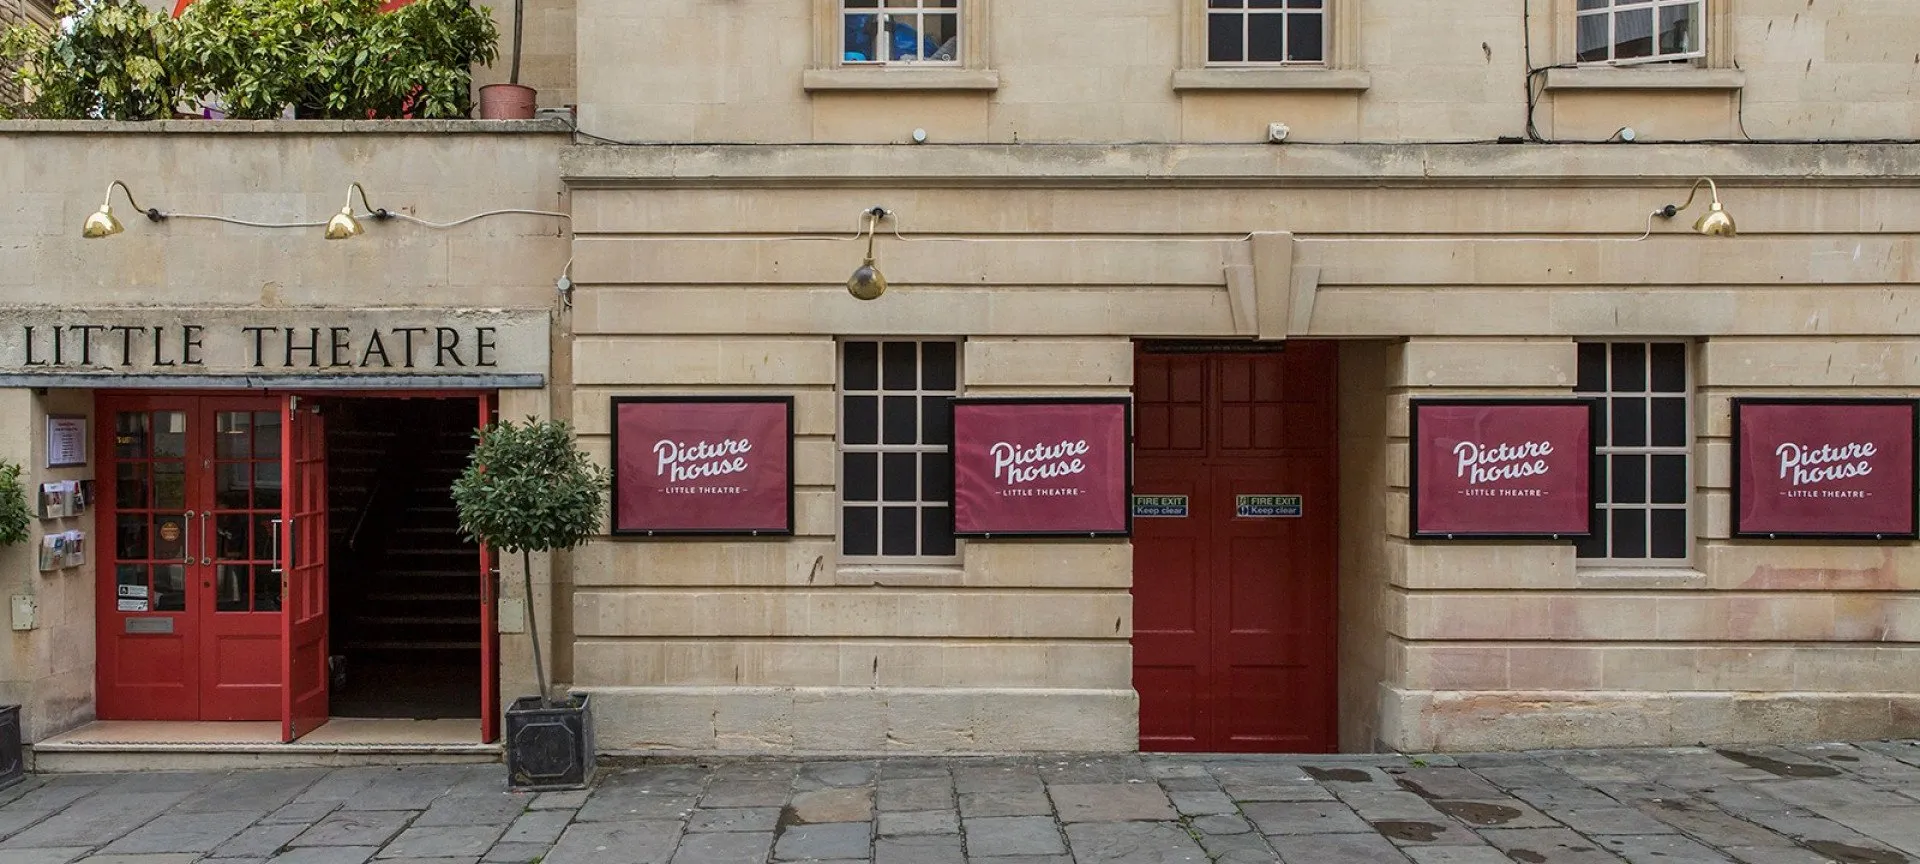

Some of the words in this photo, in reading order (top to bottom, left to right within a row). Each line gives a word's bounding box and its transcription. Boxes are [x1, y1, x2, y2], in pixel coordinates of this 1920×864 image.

[23, 324, 205, 367] LITTLE
[241, 325, 499, 368] THEATRE
[653, 438, 752, 476] Picture
[670, 456, 749, 482] house
[990, 439, 1090, 478] Picture
[1453, 440, 1554, 478] Picture
[1775, 442, 1878, 479] Picture
[1007, 458, 1086, 485] house
[1470, 459, 1549, 485] house
[1793, 460, 1873, 486] house
[665, 486, 696, 494] LITTLE
[699, 486, 741, 494] THEATRE
[1002, 488, 1033, 497] LITTLE
[1036, 487, 1079, 496] THEATRE
[1137, 497, 1159, 505] FIRE
[1161, 497, 1183, 505] EXIT
[1251, 497, 1273, 505] FIRE
[1275, 497, 1297, 505] EXIT
[1465, 489, 1496, 497] LITTLE
[1499, 489, 1542, 497] THEATRE
[1787, 490, 1819, 498] LITTLE
[1822, 490, 1865, 498] THEATRE
[1137, 506, 1160, 515] Keep
[1161, 506, 1183, 514] clear
[1251, 506, 1274, 515] Keep
[1275, 506, 1297, 514] clear
